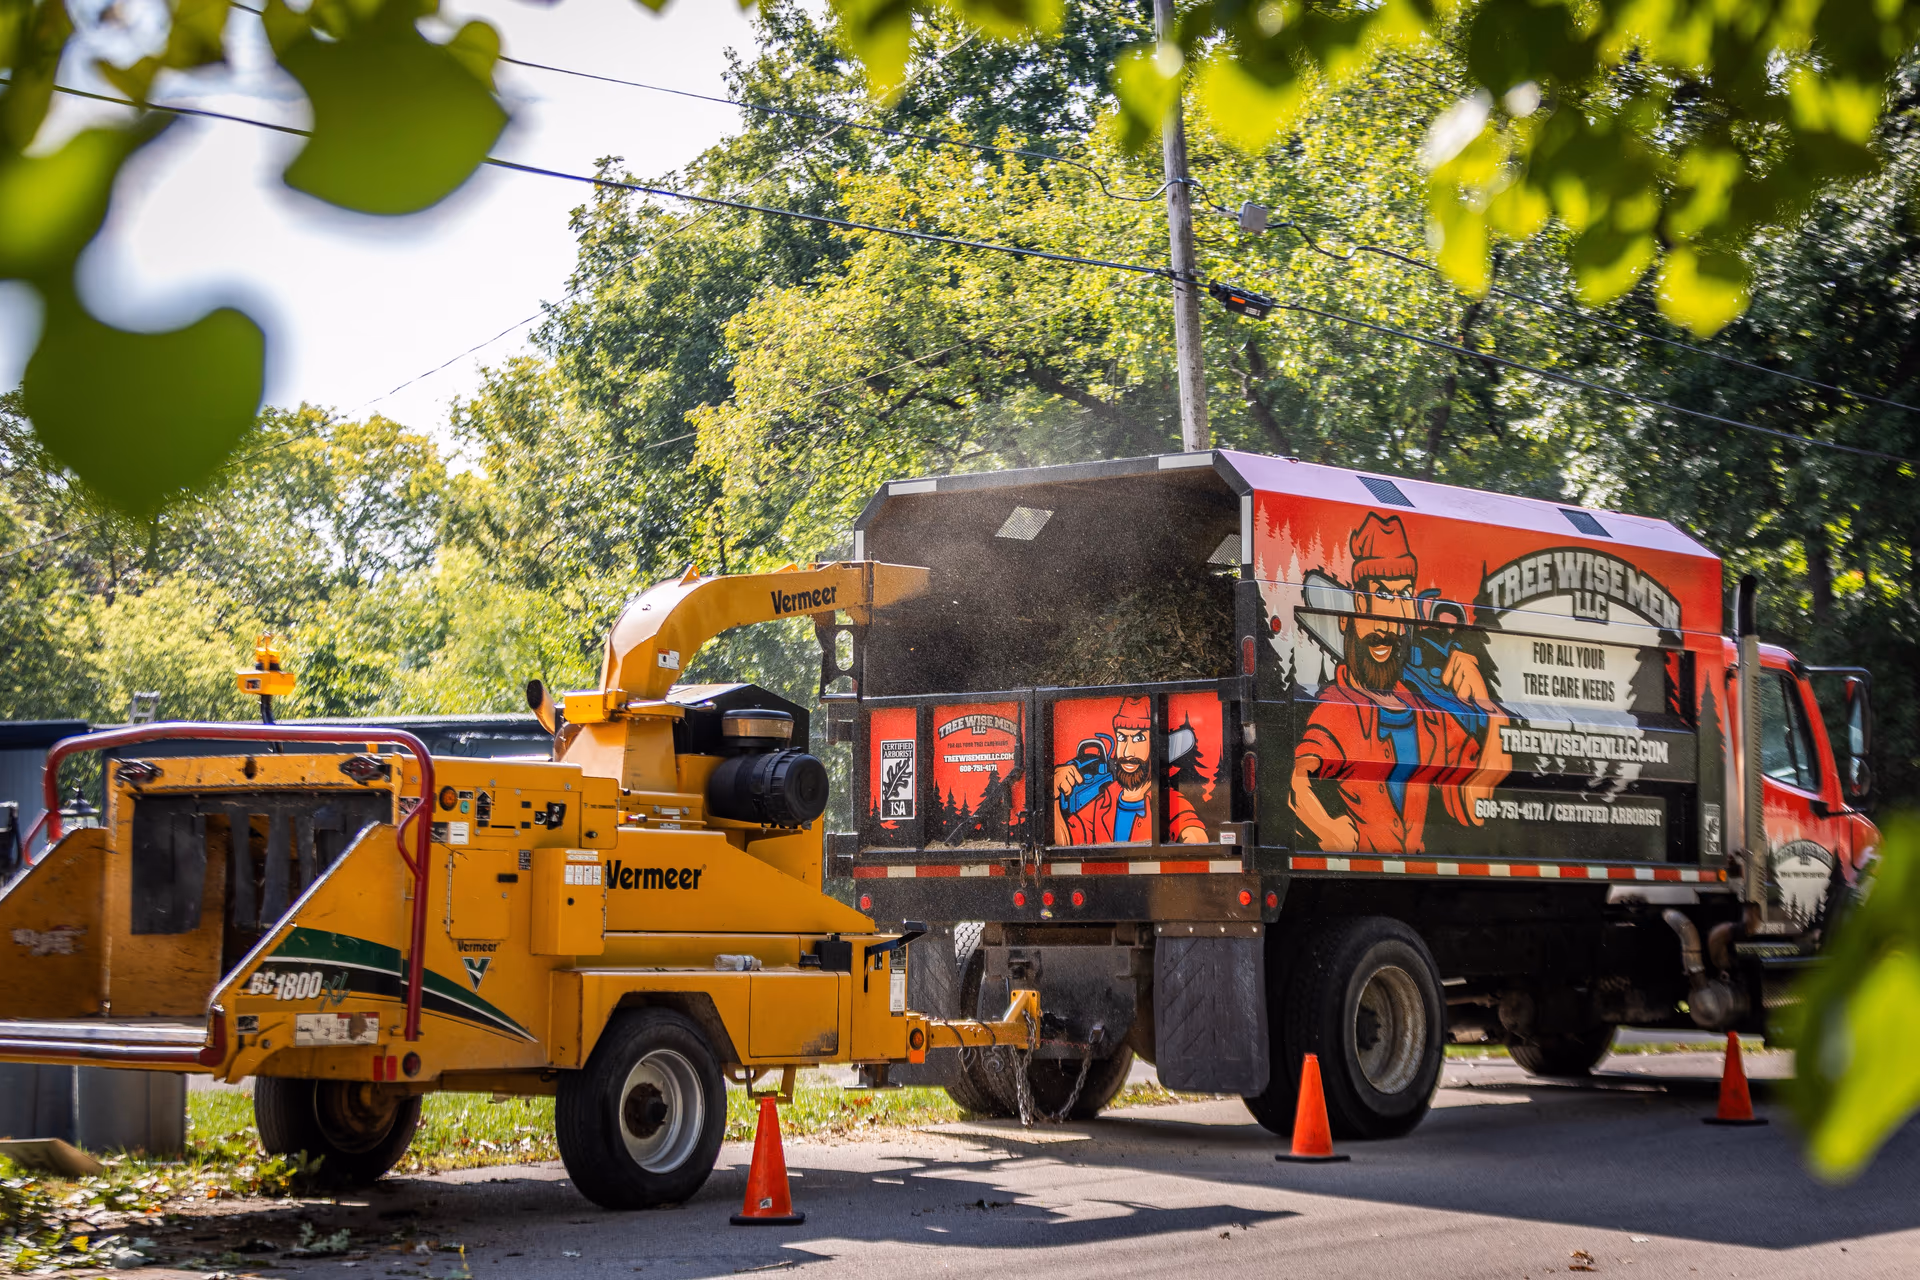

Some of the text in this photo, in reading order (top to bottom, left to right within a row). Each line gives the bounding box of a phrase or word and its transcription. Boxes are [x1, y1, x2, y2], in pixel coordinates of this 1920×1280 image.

[770, 585, 837, 615] Vermeer
[1487, 552, 1682, 640] TREE WISE MEN
[1573, 591, 1608, 620] LLC
[1533, 641, 1605, 670] FOR ALL YOUR
[1523, 672, 1615, 702] TREE CARE NEEDS
[939, 715, 1018, 738] TREE WISE MEN
[972, 726, 987, 734] LLC
[883, 742, 913, 751] CERTIFIED
[883, 750, 912, 758] ARBORIST
[943, 753, 1015, 763] TREEWISEMENLLC.COM
[1500, 728, 1670, 764] TREEWISEMENLLC.COM
[959, 764, 998, 773] 608-751-4171
[890, 801, 907, 816] ISA
[1475, 800, 1545, 821] 608-751-4171
[1554, 804, 1609, 824] CERTIFIED
[1610, 806, 1663, 826] ARBORIST
[606, 860, 702, 890] Vermeer
[457, 940, 498, 953] Vermeer
